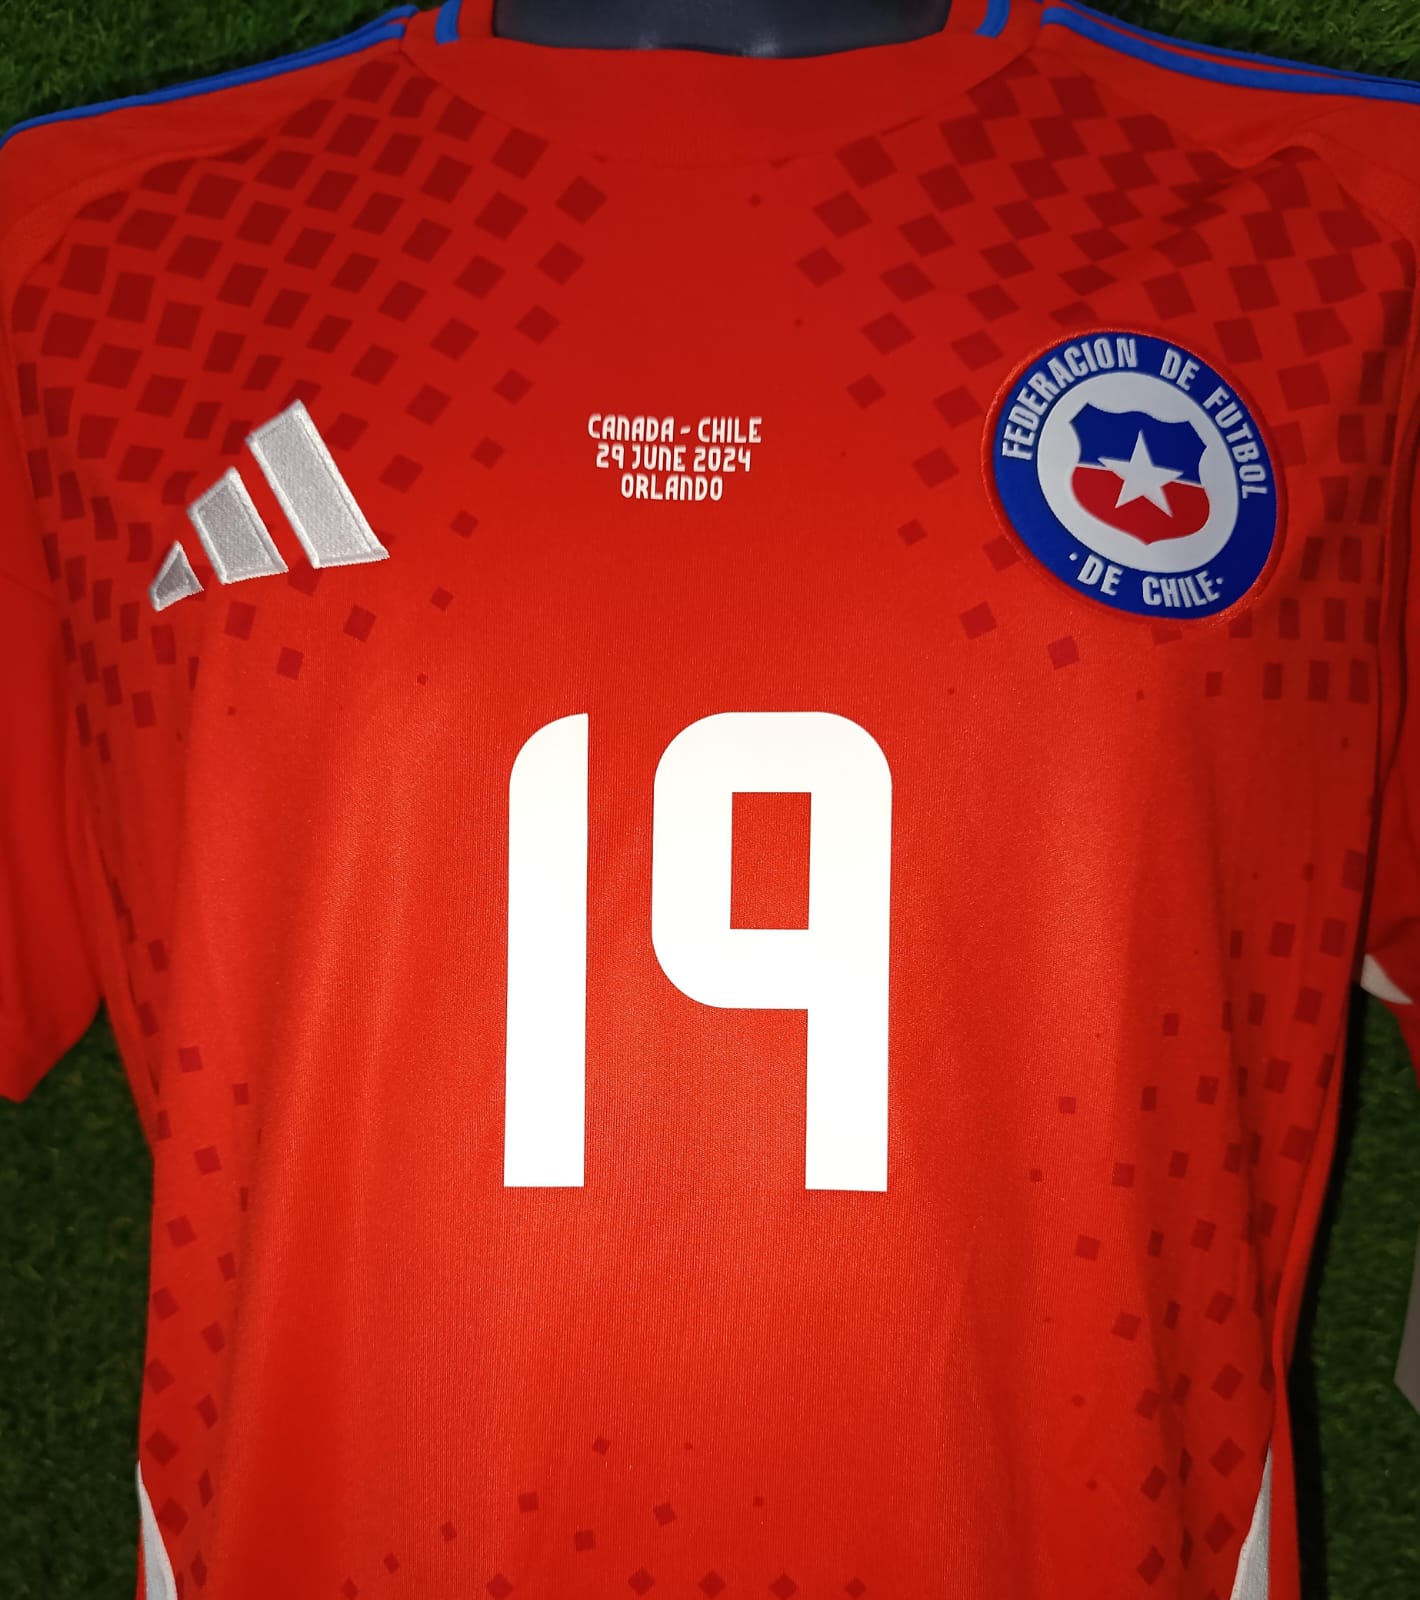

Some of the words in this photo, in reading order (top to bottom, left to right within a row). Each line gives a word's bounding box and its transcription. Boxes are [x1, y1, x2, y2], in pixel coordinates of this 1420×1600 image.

[588, 413, 675, 442] CANADA
[698, 416, 762, 443] CHILE
[1002, 337, 1138, 460] FEDERACION
[1160, 348, 1200, 391] DE
[1202, 386, 1267, 499] FUTBOL
[596, 442, 624, 469] 29
[631, 443, 686, 472] JUNE
[693, 446, 751, 472] 2024
[621, 472, 723, 501] ORLANDO
[1077, 553, 1123, 596] DE
[1142, 571, 1219, 608] CHILE
[504, 711, 892, 1192] 19
